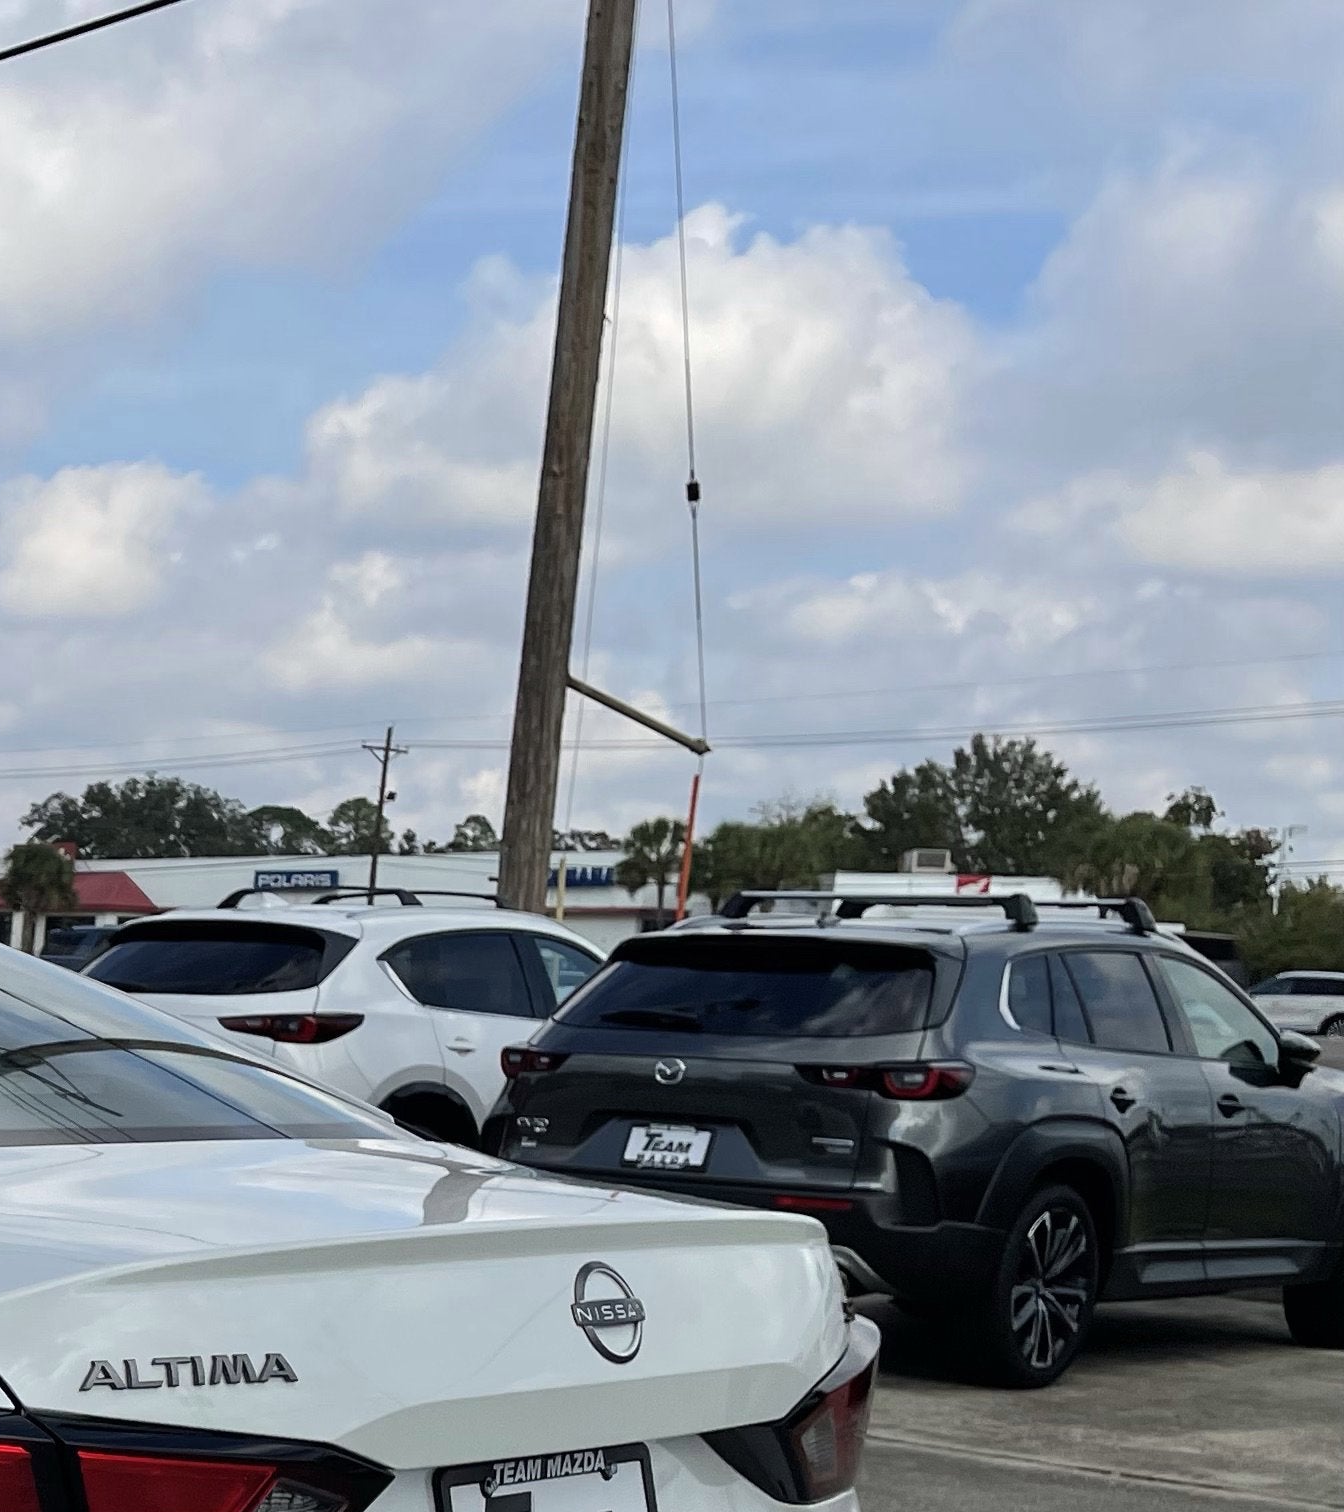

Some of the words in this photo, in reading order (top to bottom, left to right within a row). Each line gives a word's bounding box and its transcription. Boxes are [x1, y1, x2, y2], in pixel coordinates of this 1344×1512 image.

[643, 1132, 692, 1153] TEAM
[576, 1303, 643, 1321] NISSA
[79, 1353, 299, 1392] ALTIMA
[493, 1458, 541, 1485] TEAM
[546, 1449, 605, 1478] MAZDA
